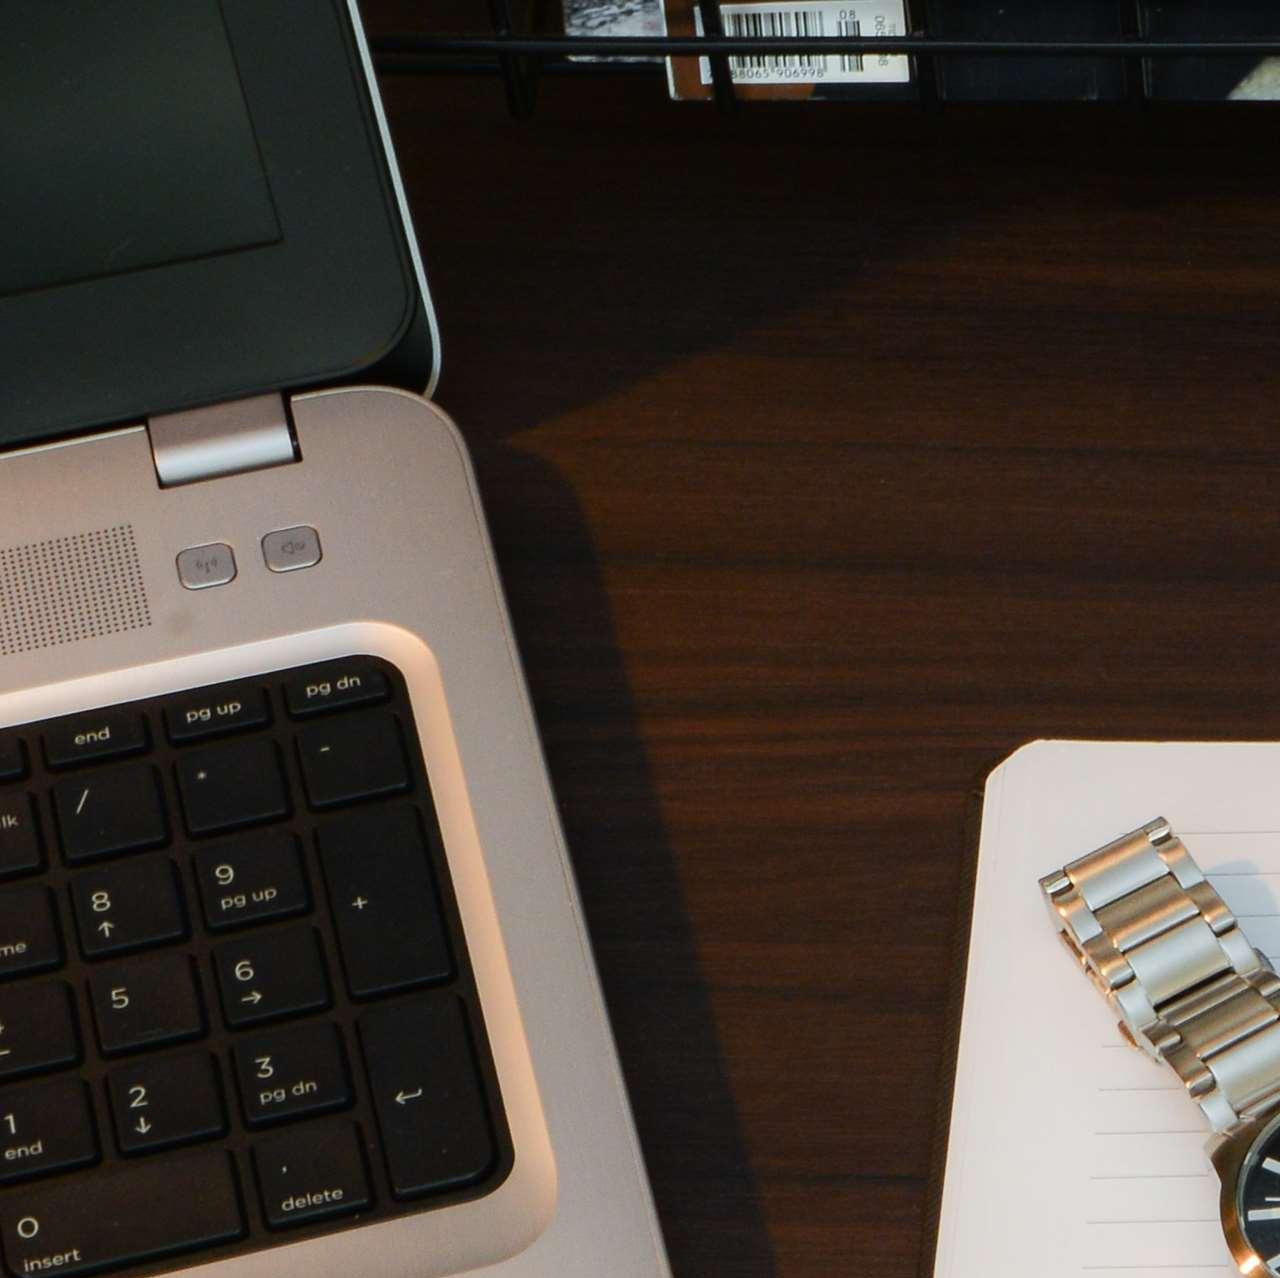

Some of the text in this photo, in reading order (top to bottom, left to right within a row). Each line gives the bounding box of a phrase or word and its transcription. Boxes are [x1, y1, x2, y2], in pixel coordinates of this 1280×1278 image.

[306, 674, 361, 699] pg dn
[186, 701, 242, 723] pg up
[74, 726, 111, 744] end
[215, 865, 234, 885] 9
[91, 891, 111, 912] 8
[220, 887, 277, 911] pg up
[234, 961, 254, 981] 6
[111, 988, 129, 1009] 5
[255, 1057, 274, 1079] 3
[129, 1086, 149, 1108] 2
[259, 1079, 317, 1105] pg dn
[4, 1114, 17, 1134] 1
[4, 1140, 43, 1160] end
[281, 1189, 344, 1212] delete
[23, 1248, 81, 1273] insert
